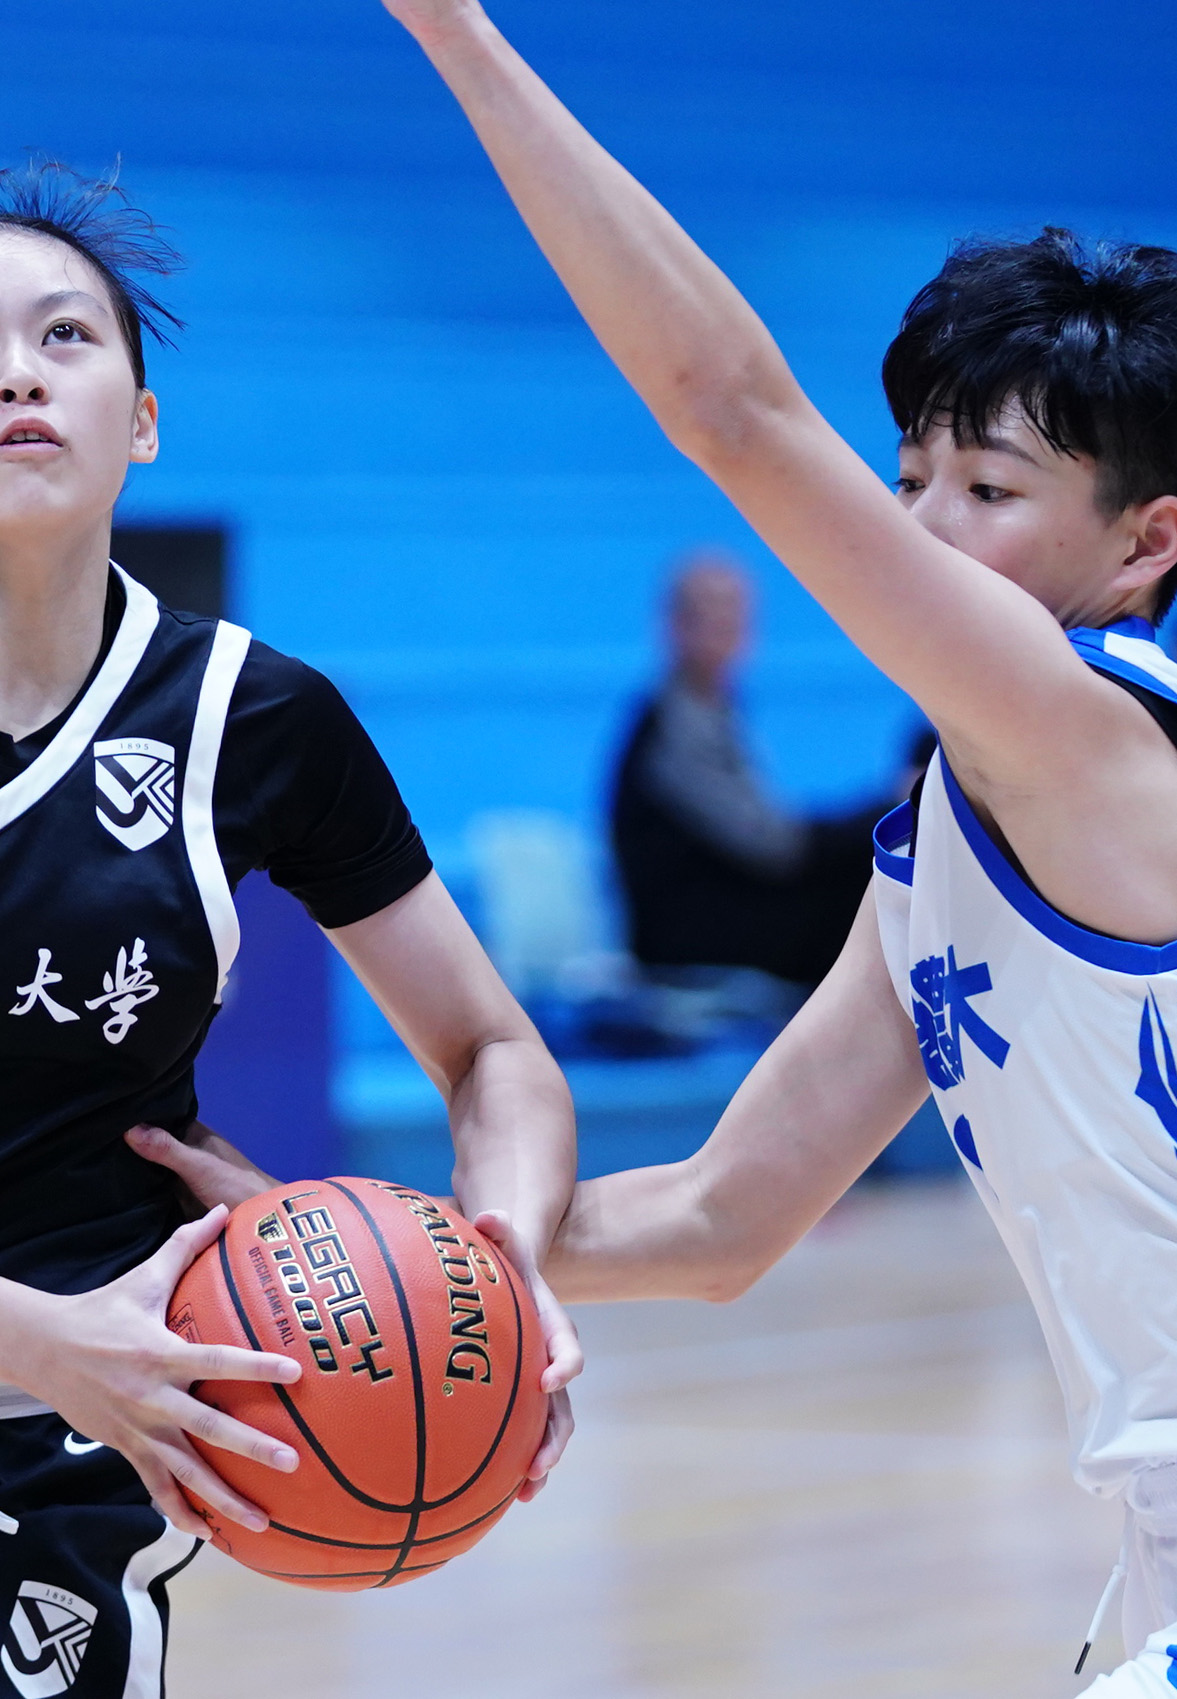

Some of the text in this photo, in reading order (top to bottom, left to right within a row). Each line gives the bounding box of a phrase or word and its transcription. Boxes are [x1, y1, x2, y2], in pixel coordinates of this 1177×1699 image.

[119, 742, 150, 751] 1895
[249, 1247, 295, 1347] OFFICIAL GAME BALL
[272, 1245, 339, 1373] 1000
[282, 1190, 395, 1385] LEGACY
[46, 1589, 73, 1605] 1895
